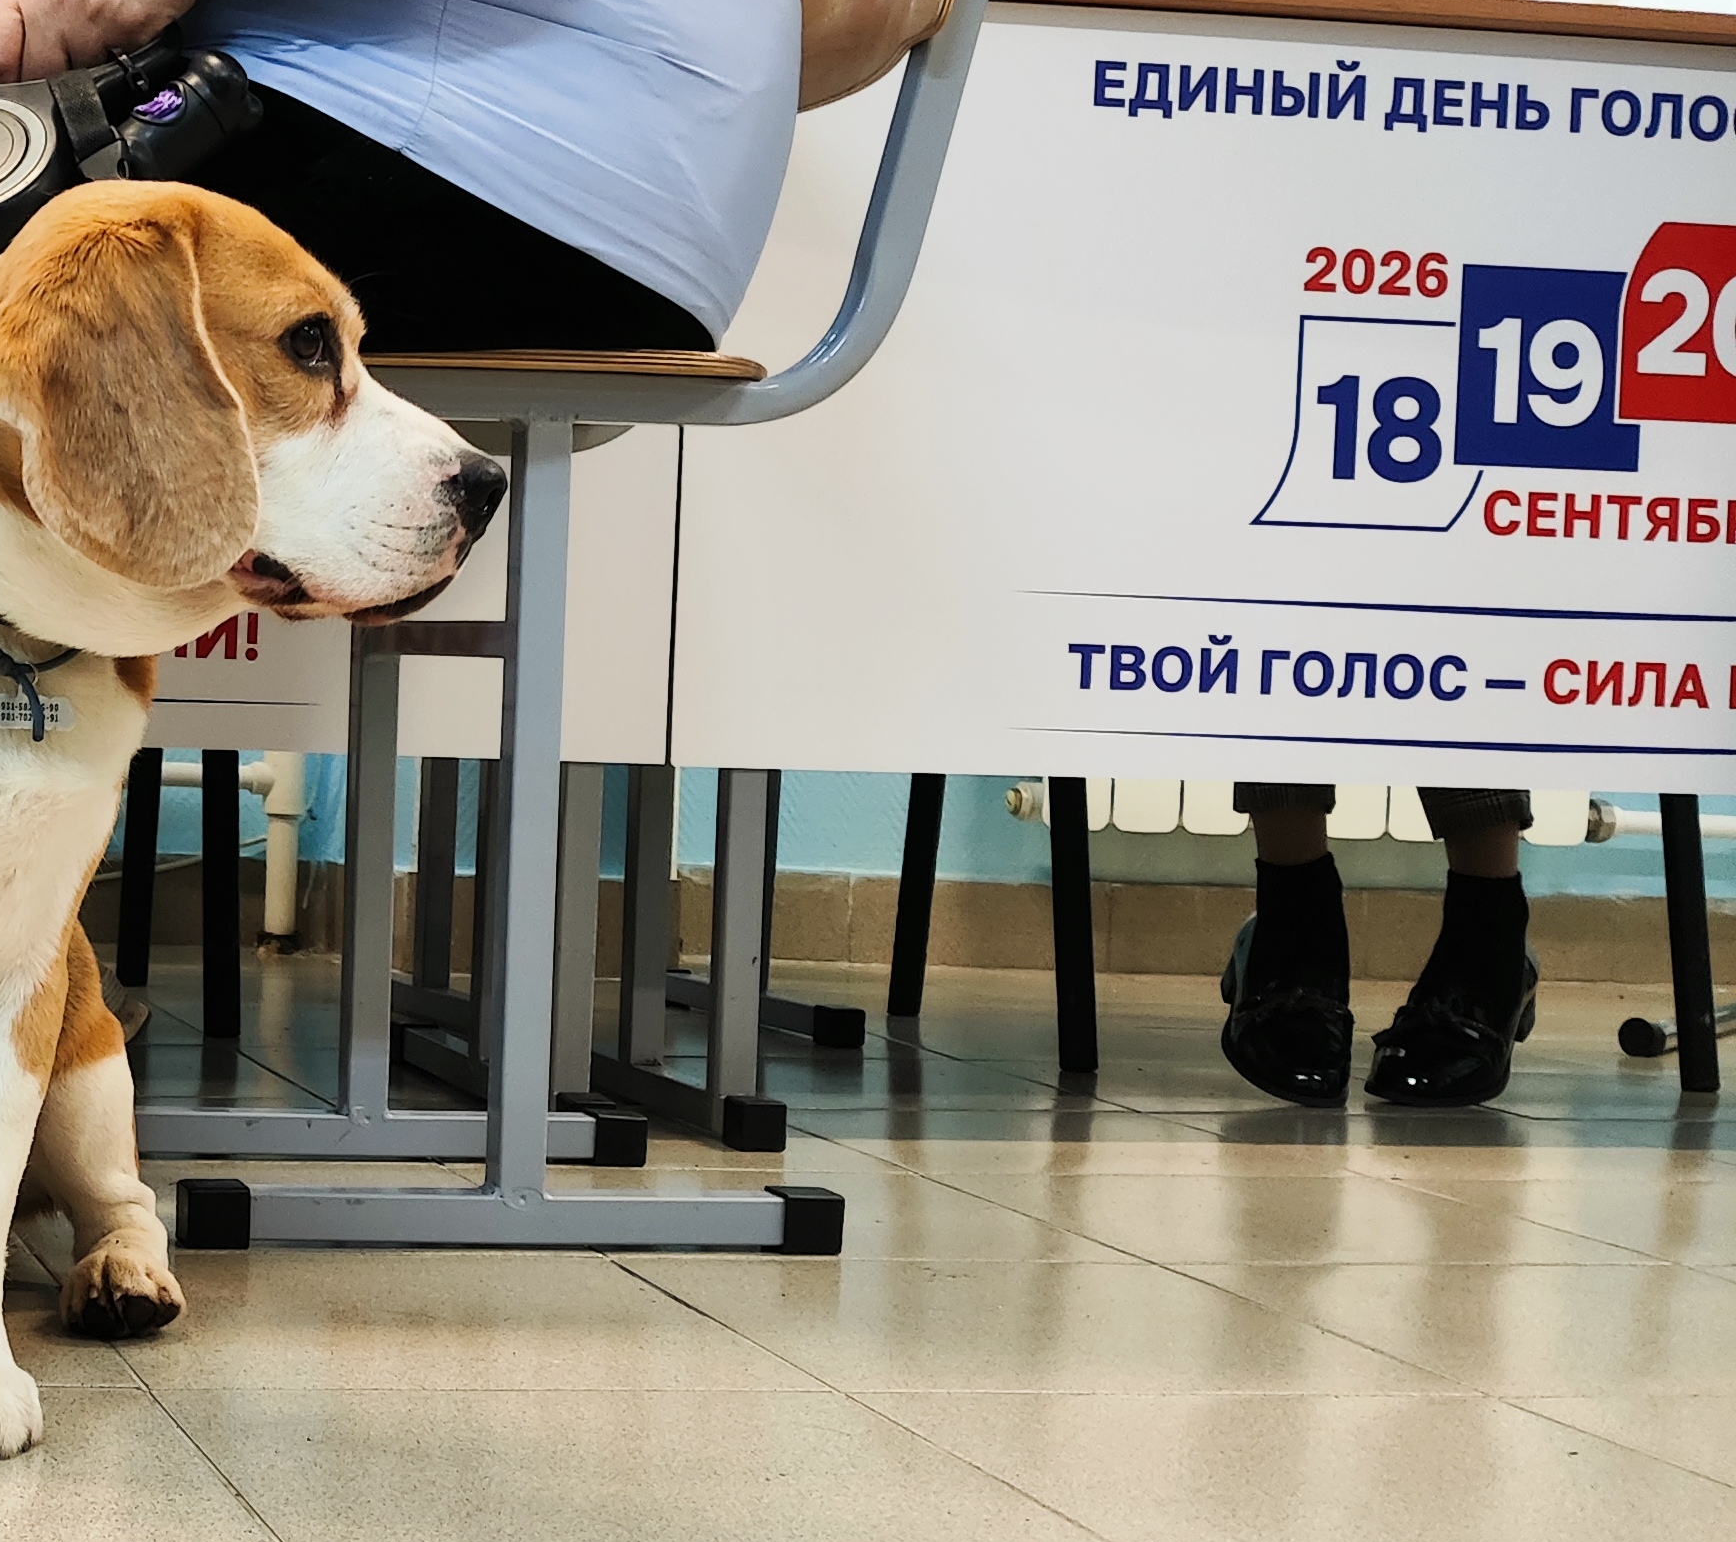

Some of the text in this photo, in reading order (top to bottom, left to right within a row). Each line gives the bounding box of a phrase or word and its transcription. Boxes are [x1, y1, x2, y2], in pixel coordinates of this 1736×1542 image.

[1093, 59, 1736, 143] ЕДИНЫЙ ДЕНЬ ГОЛО
[1303, 247, 1449, 298] 2026
[1317, 375, 1442, 483] 18
[1478, 317, 1604, 427] 19
[1484, 490, 1736, 544] СЕНТЯБ
[1068, 634, 1239, 694] ТВОЙ
[1260, 650, 1468, 702] ГОЛОС
[1544, 658, 1710, 709] СИЛА
